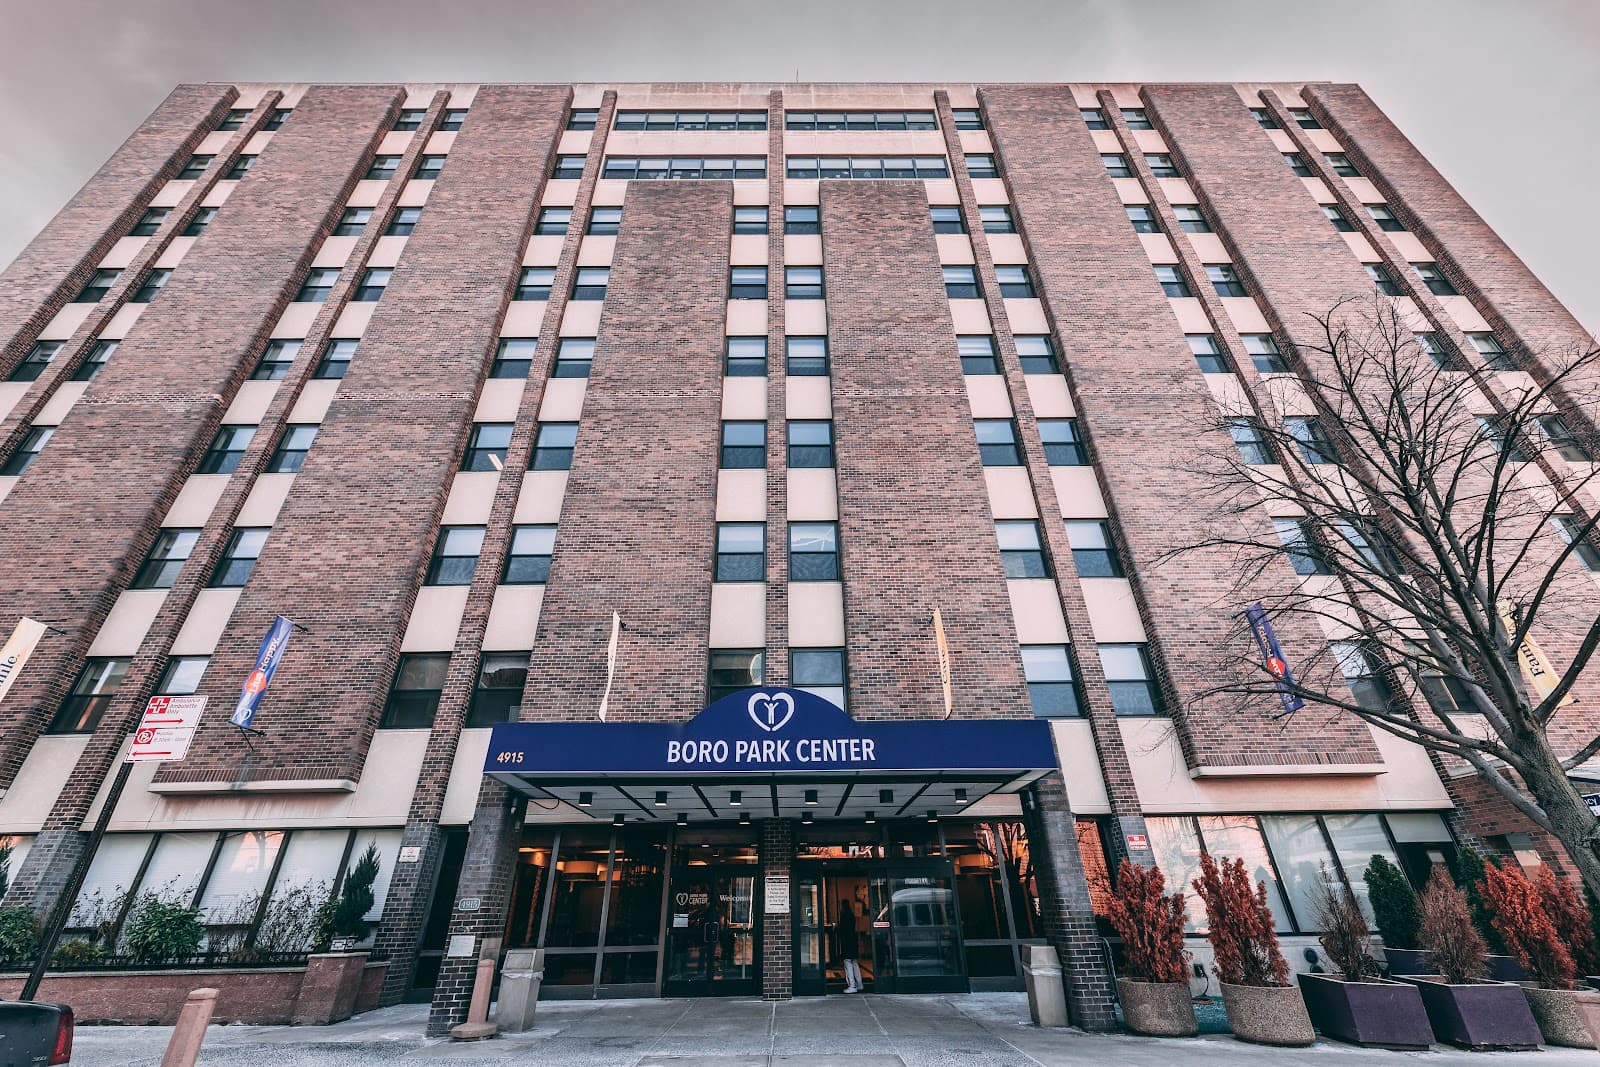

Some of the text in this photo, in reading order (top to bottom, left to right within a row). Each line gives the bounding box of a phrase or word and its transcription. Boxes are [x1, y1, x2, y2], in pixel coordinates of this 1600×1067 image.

[667, 738, 876, 763] BORO PARK CENTER
[497, 751, 524, 763] 4915
[461, 900, 478, 909] 4915
